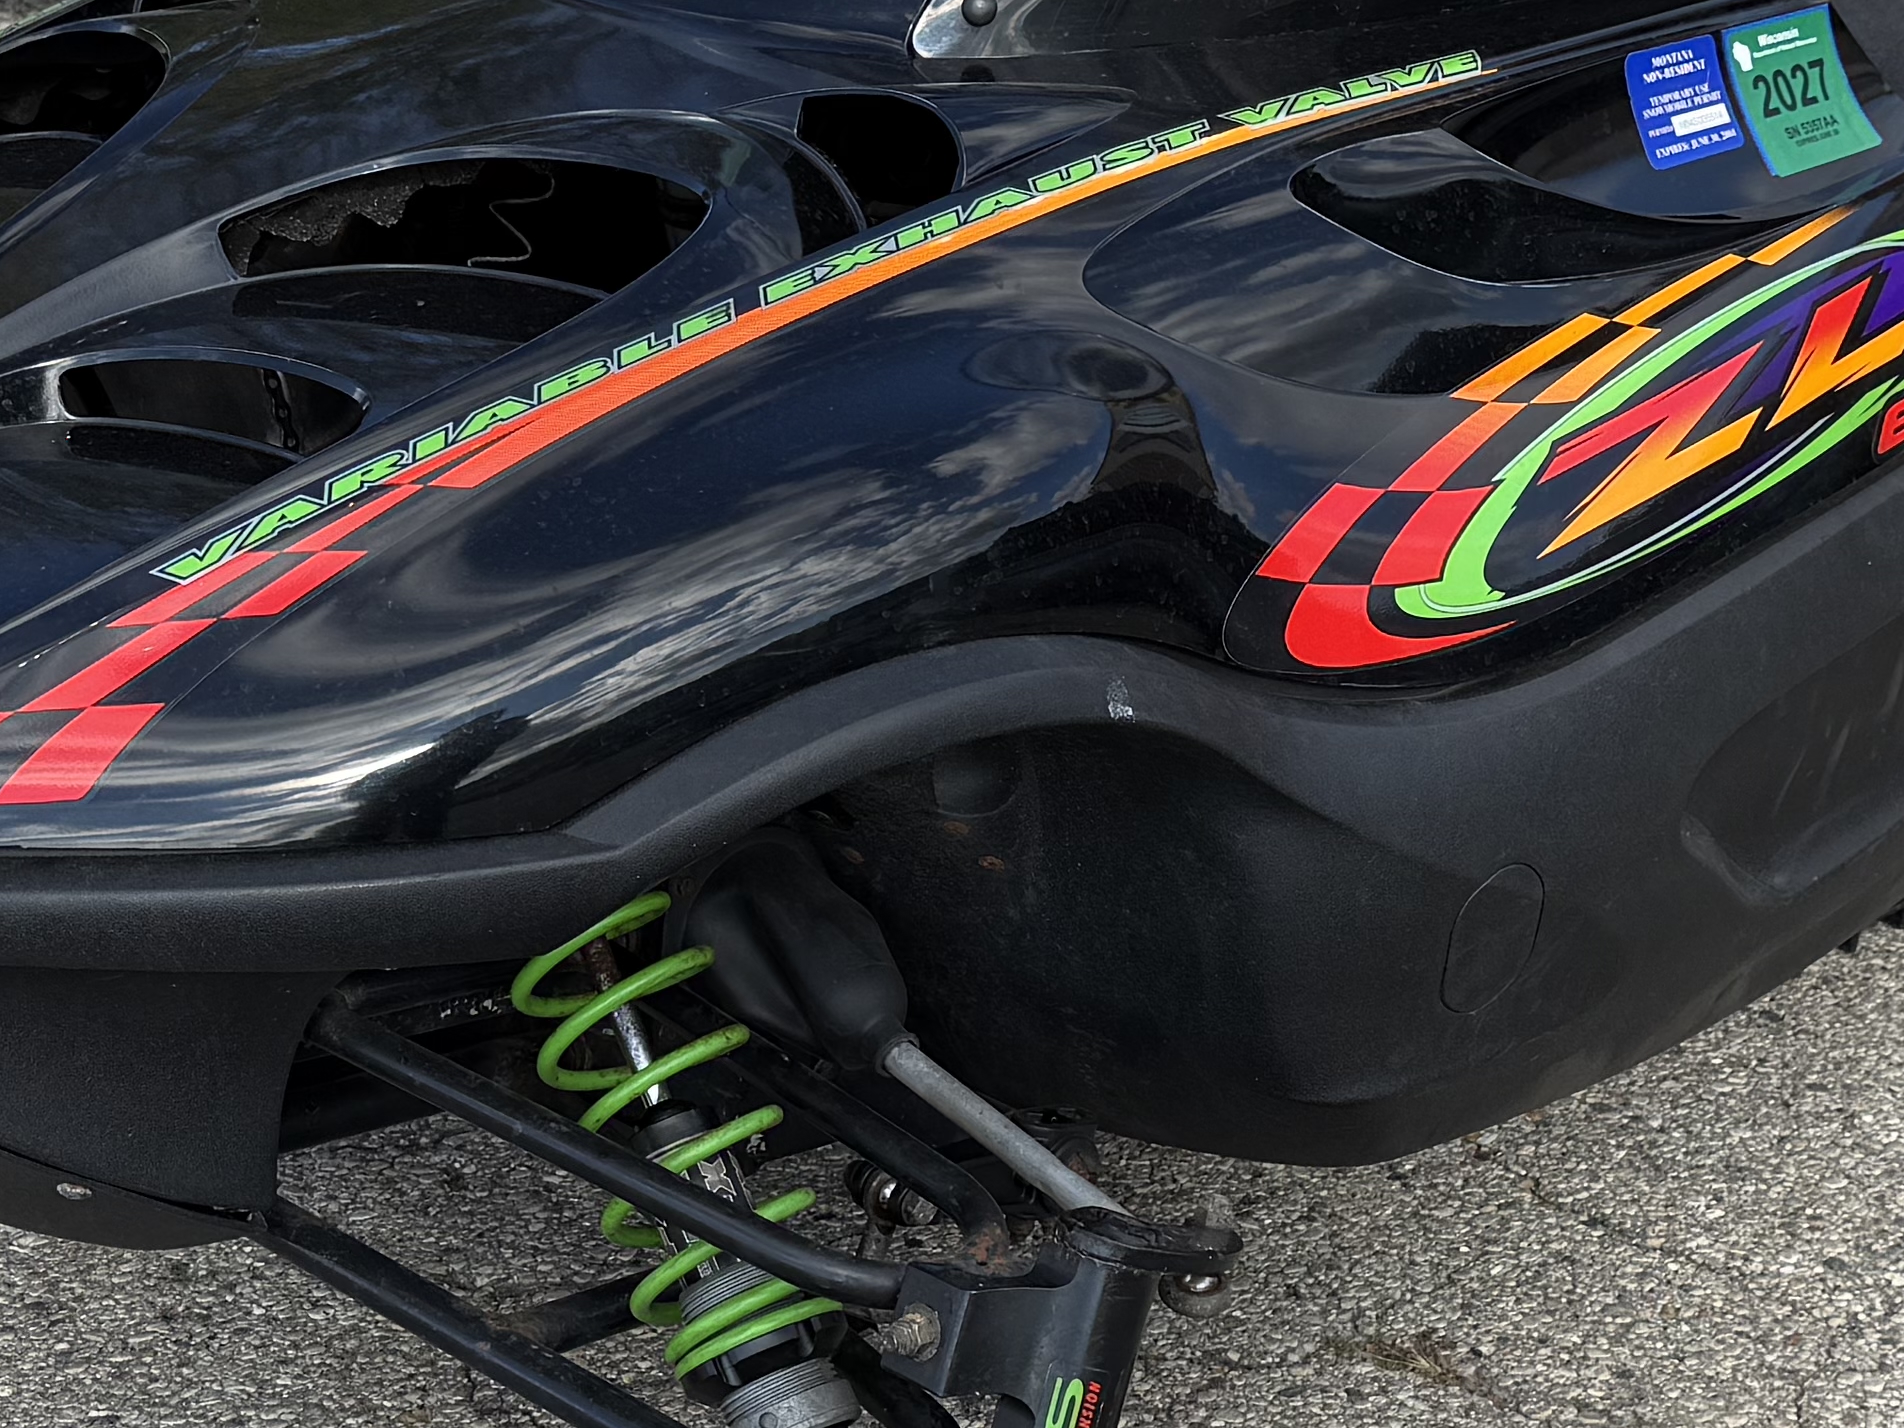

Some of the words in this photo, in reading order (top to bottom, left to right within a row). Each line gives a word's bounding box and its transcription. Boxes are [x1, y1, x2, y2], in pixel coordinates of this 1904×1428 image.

[1752, 57, 1829, 119] 2027
[152, 298, 737, 586] VARIABLE
[760, 118, 1210, 308] EXHAUST
[1219, 49, 1482, 128] VALVE
